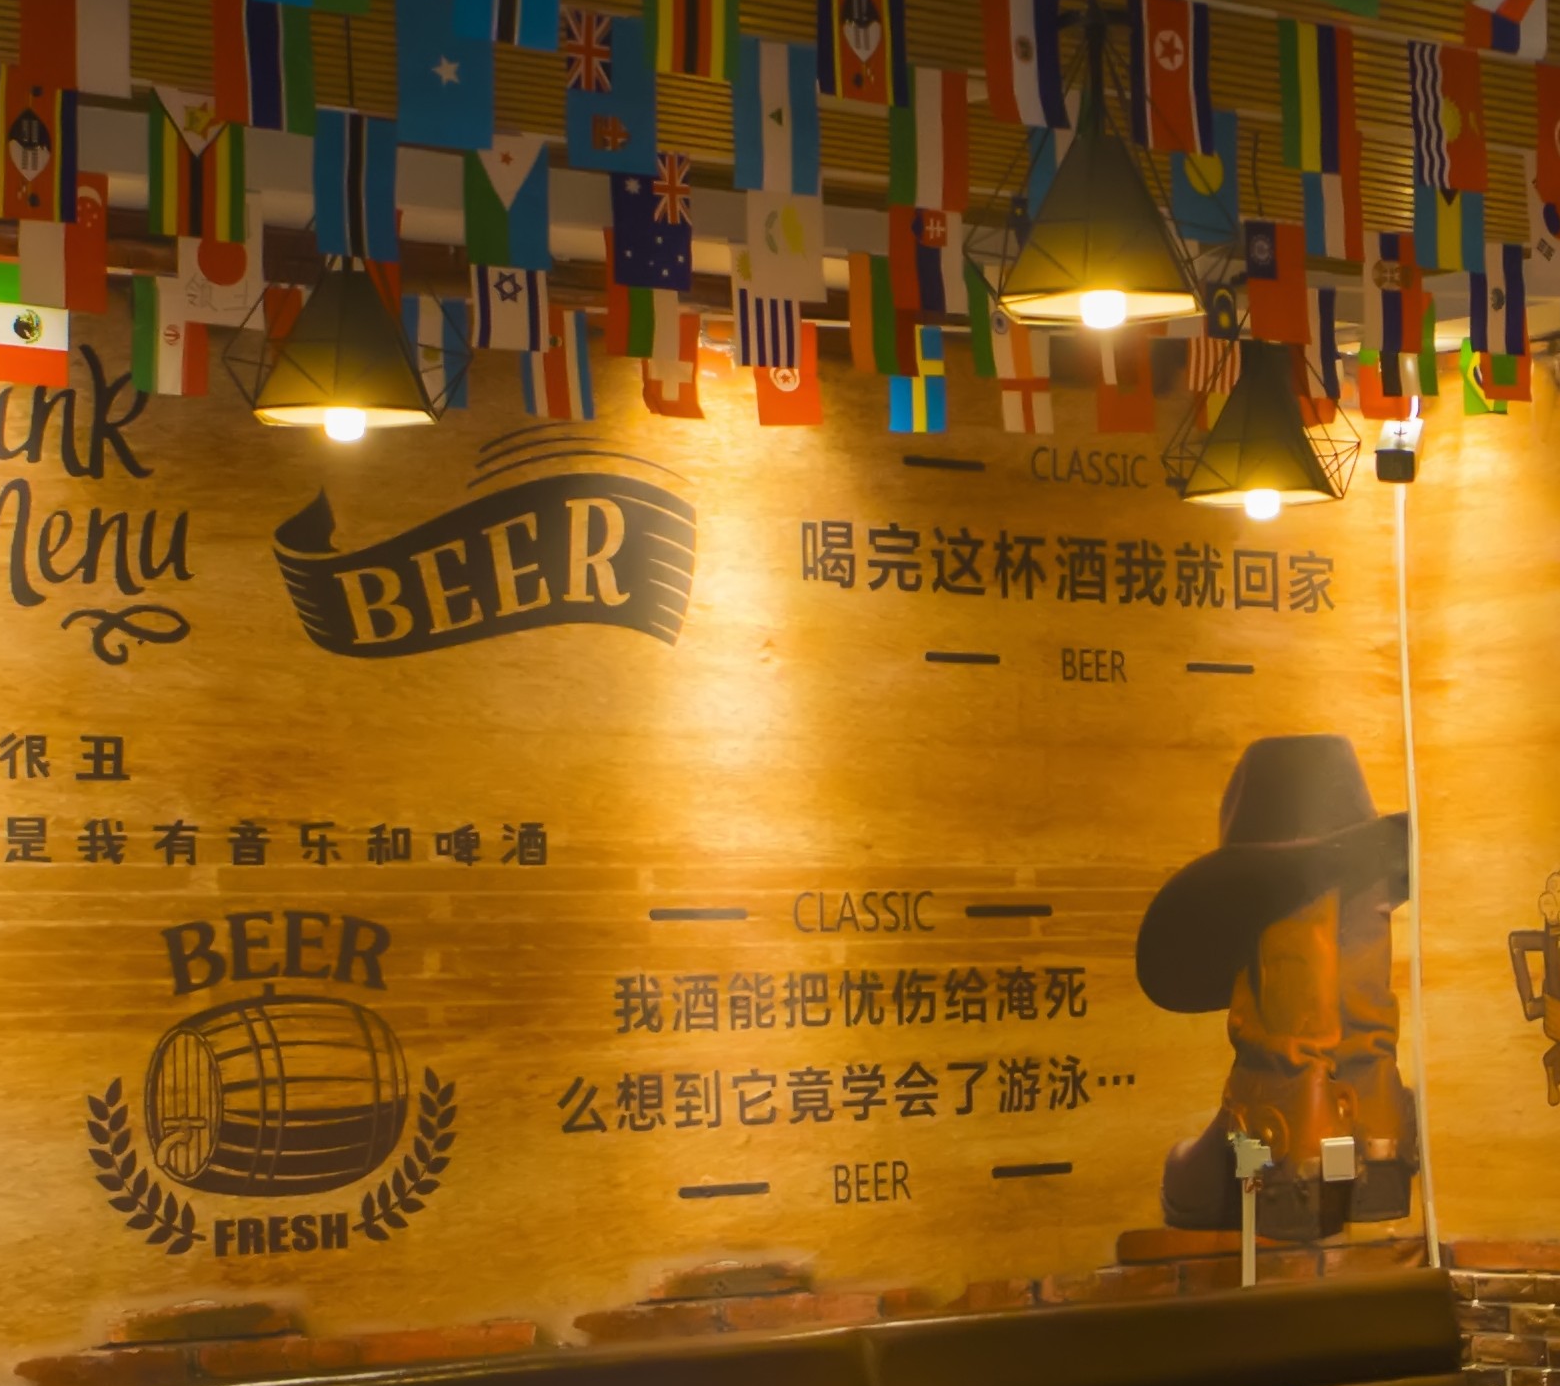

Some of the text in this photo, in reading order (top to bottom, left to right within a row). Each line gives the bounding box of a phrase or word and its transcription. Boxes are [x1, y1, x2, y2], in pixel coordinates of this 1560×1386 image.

[1030, 446, 1148, 490] CLASSIC
[331, 496, 634, 647] BEER
[801, 519, 1337, 614] 喝完这杯酒我就回家
[1061, 647, 1128, 684] BEER
[792, 889, 937, 934] CLASSIC
[159, 910, 394, 997] BEER
[613, 965, 1088, 1035] 我酒能把忧伤给淹死
[833, 1160, 913, 1204] BEER
[212, 1214, 350, 1258] FRESH
